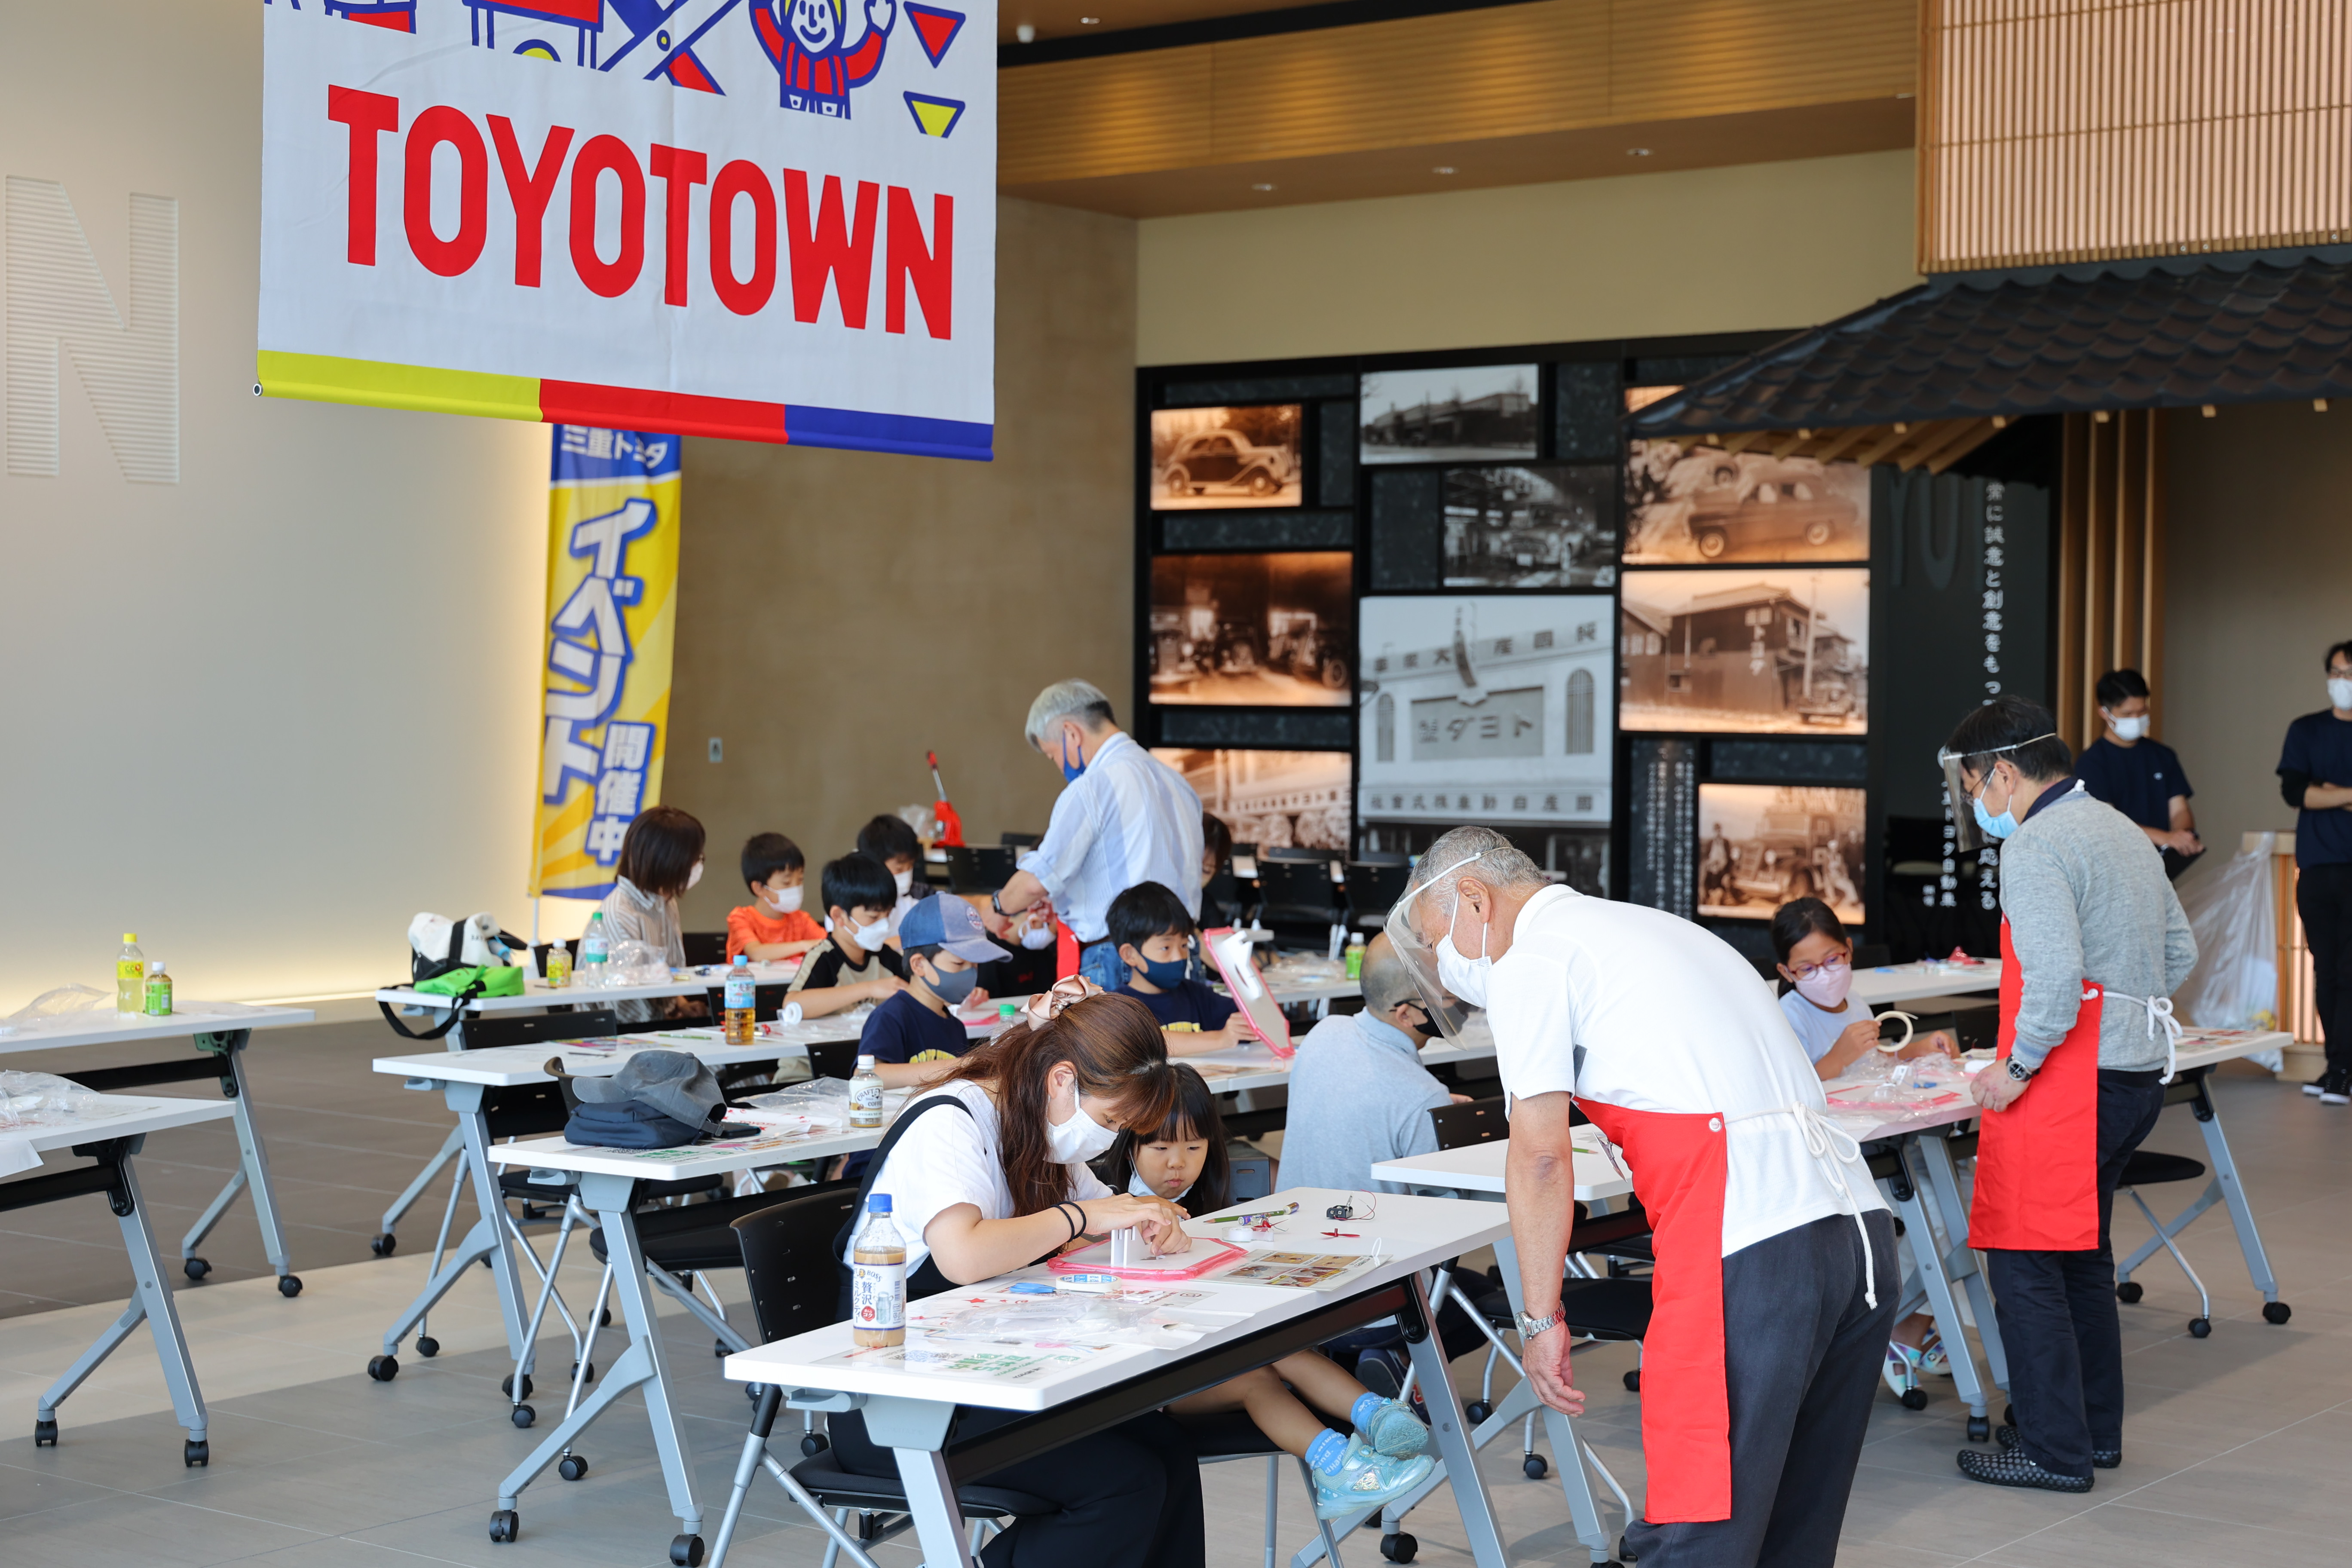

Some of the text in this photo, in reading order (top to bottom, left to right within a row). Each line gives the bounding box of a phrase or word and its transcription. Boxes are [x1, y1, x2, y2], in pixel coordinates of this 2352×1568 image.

[327, 83, 954, 340] TOYOTOWN
[544, 499, 654, 799] イベント
[588, 723, 651, 862] 開催中
[857, 1088, 874, 1101] CRAFT
[861, 1281, 873, 1305] 贅沢
[867, 1270, 882, 1283] BOSS
